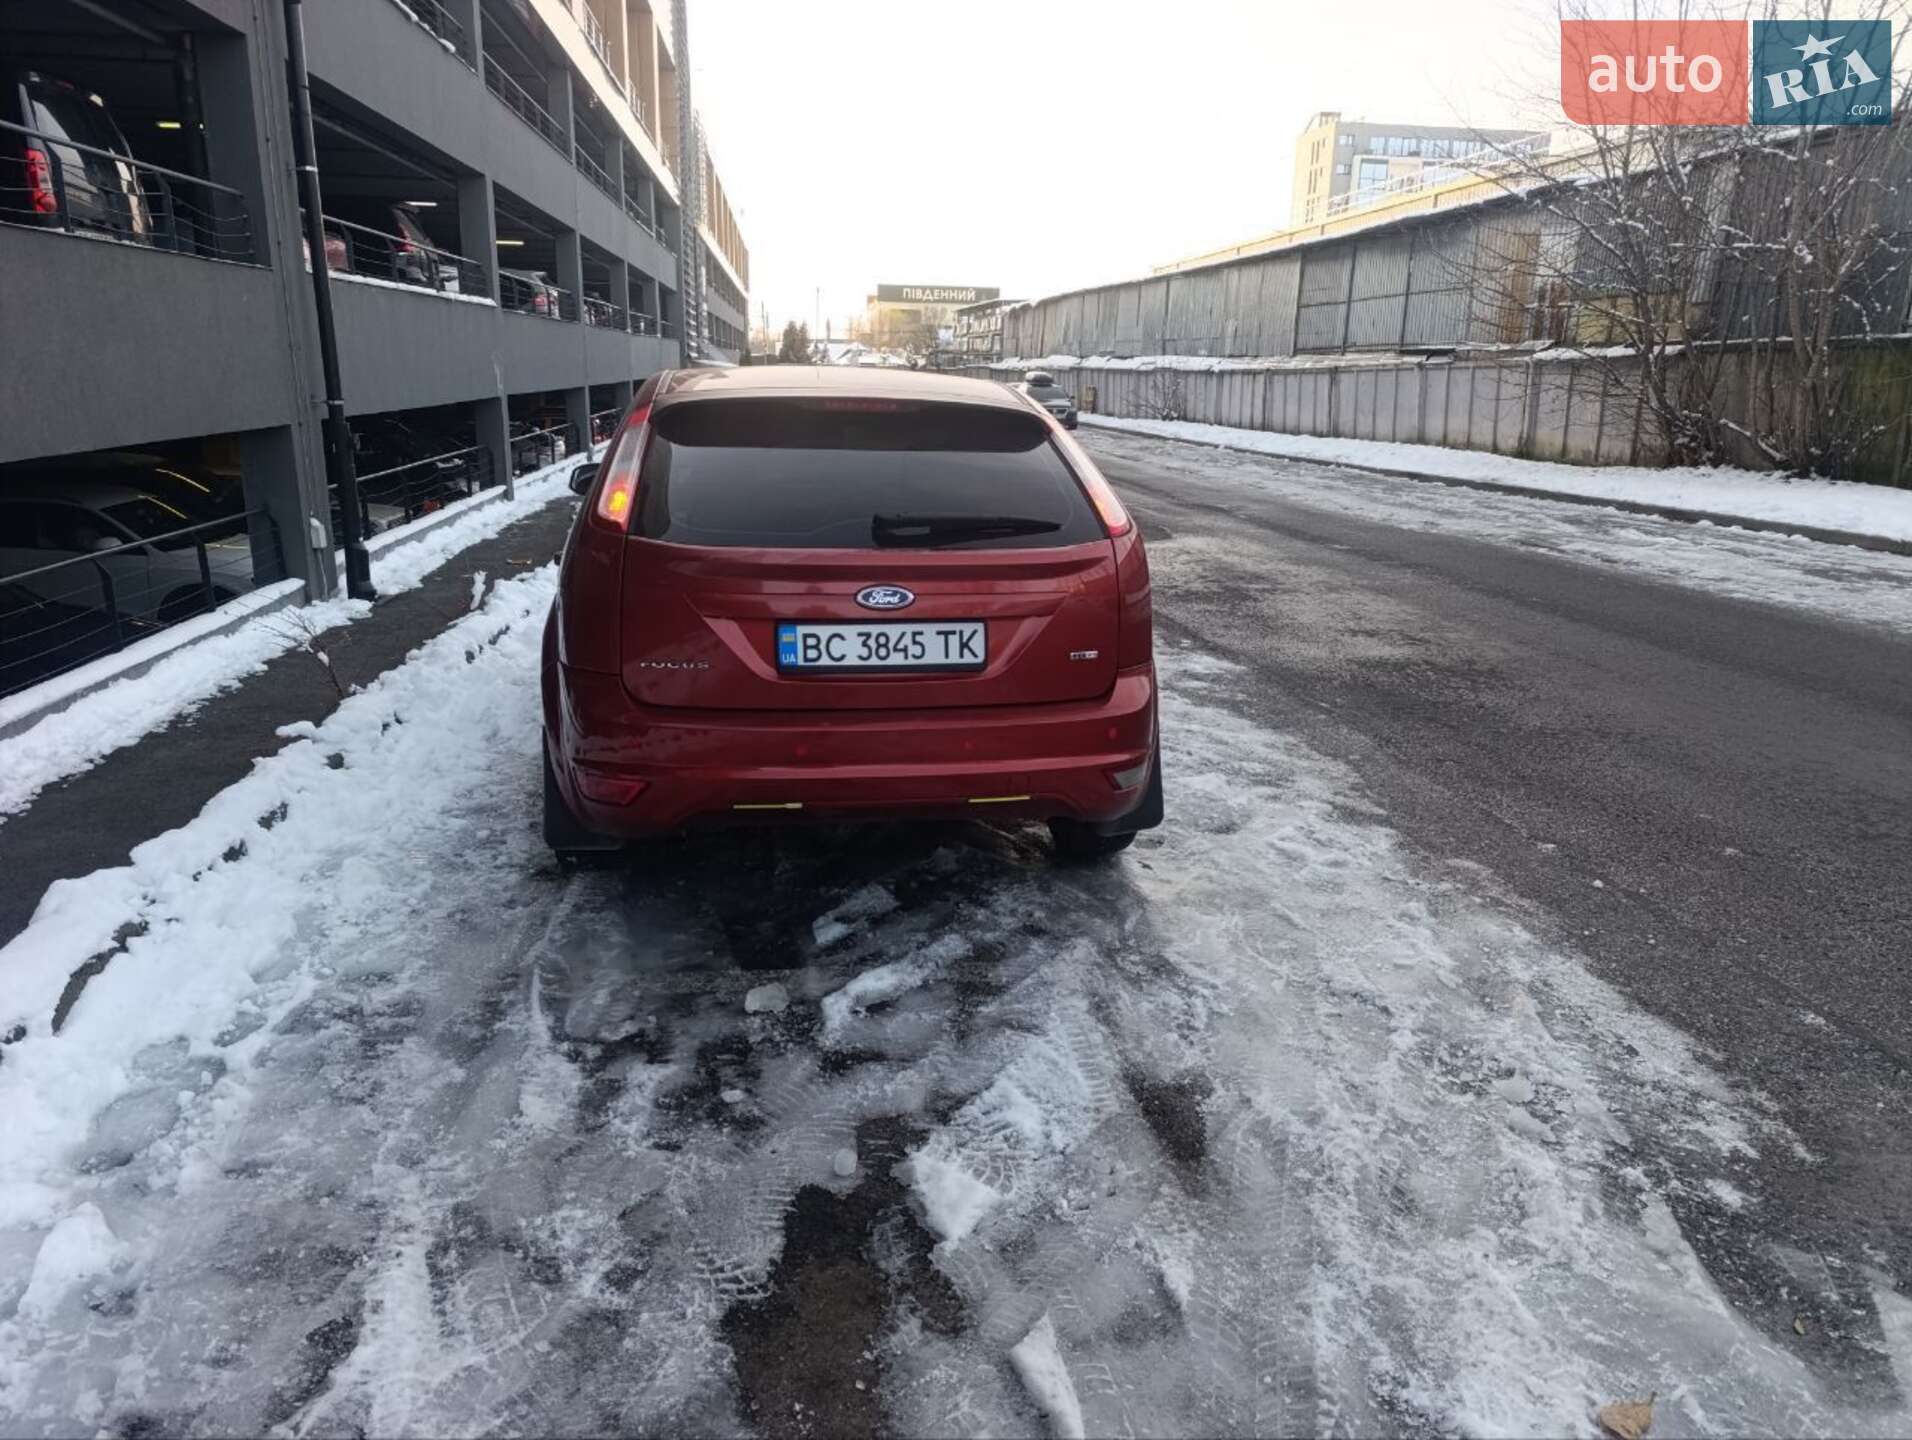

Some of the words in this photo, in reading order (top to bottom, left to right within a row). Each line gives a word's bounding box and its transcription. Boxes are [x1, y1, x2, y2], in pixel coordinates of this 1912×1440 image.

[903, 287, 976, 301] ПІВДЕННИЙ
[868, 589, 901, 605] Ford
[802, 633, 847, 663] BC
[856, 631, 926, 661] 3845
[936, 629, 979, 659] TK
[782, 653, 796, 663] UA
